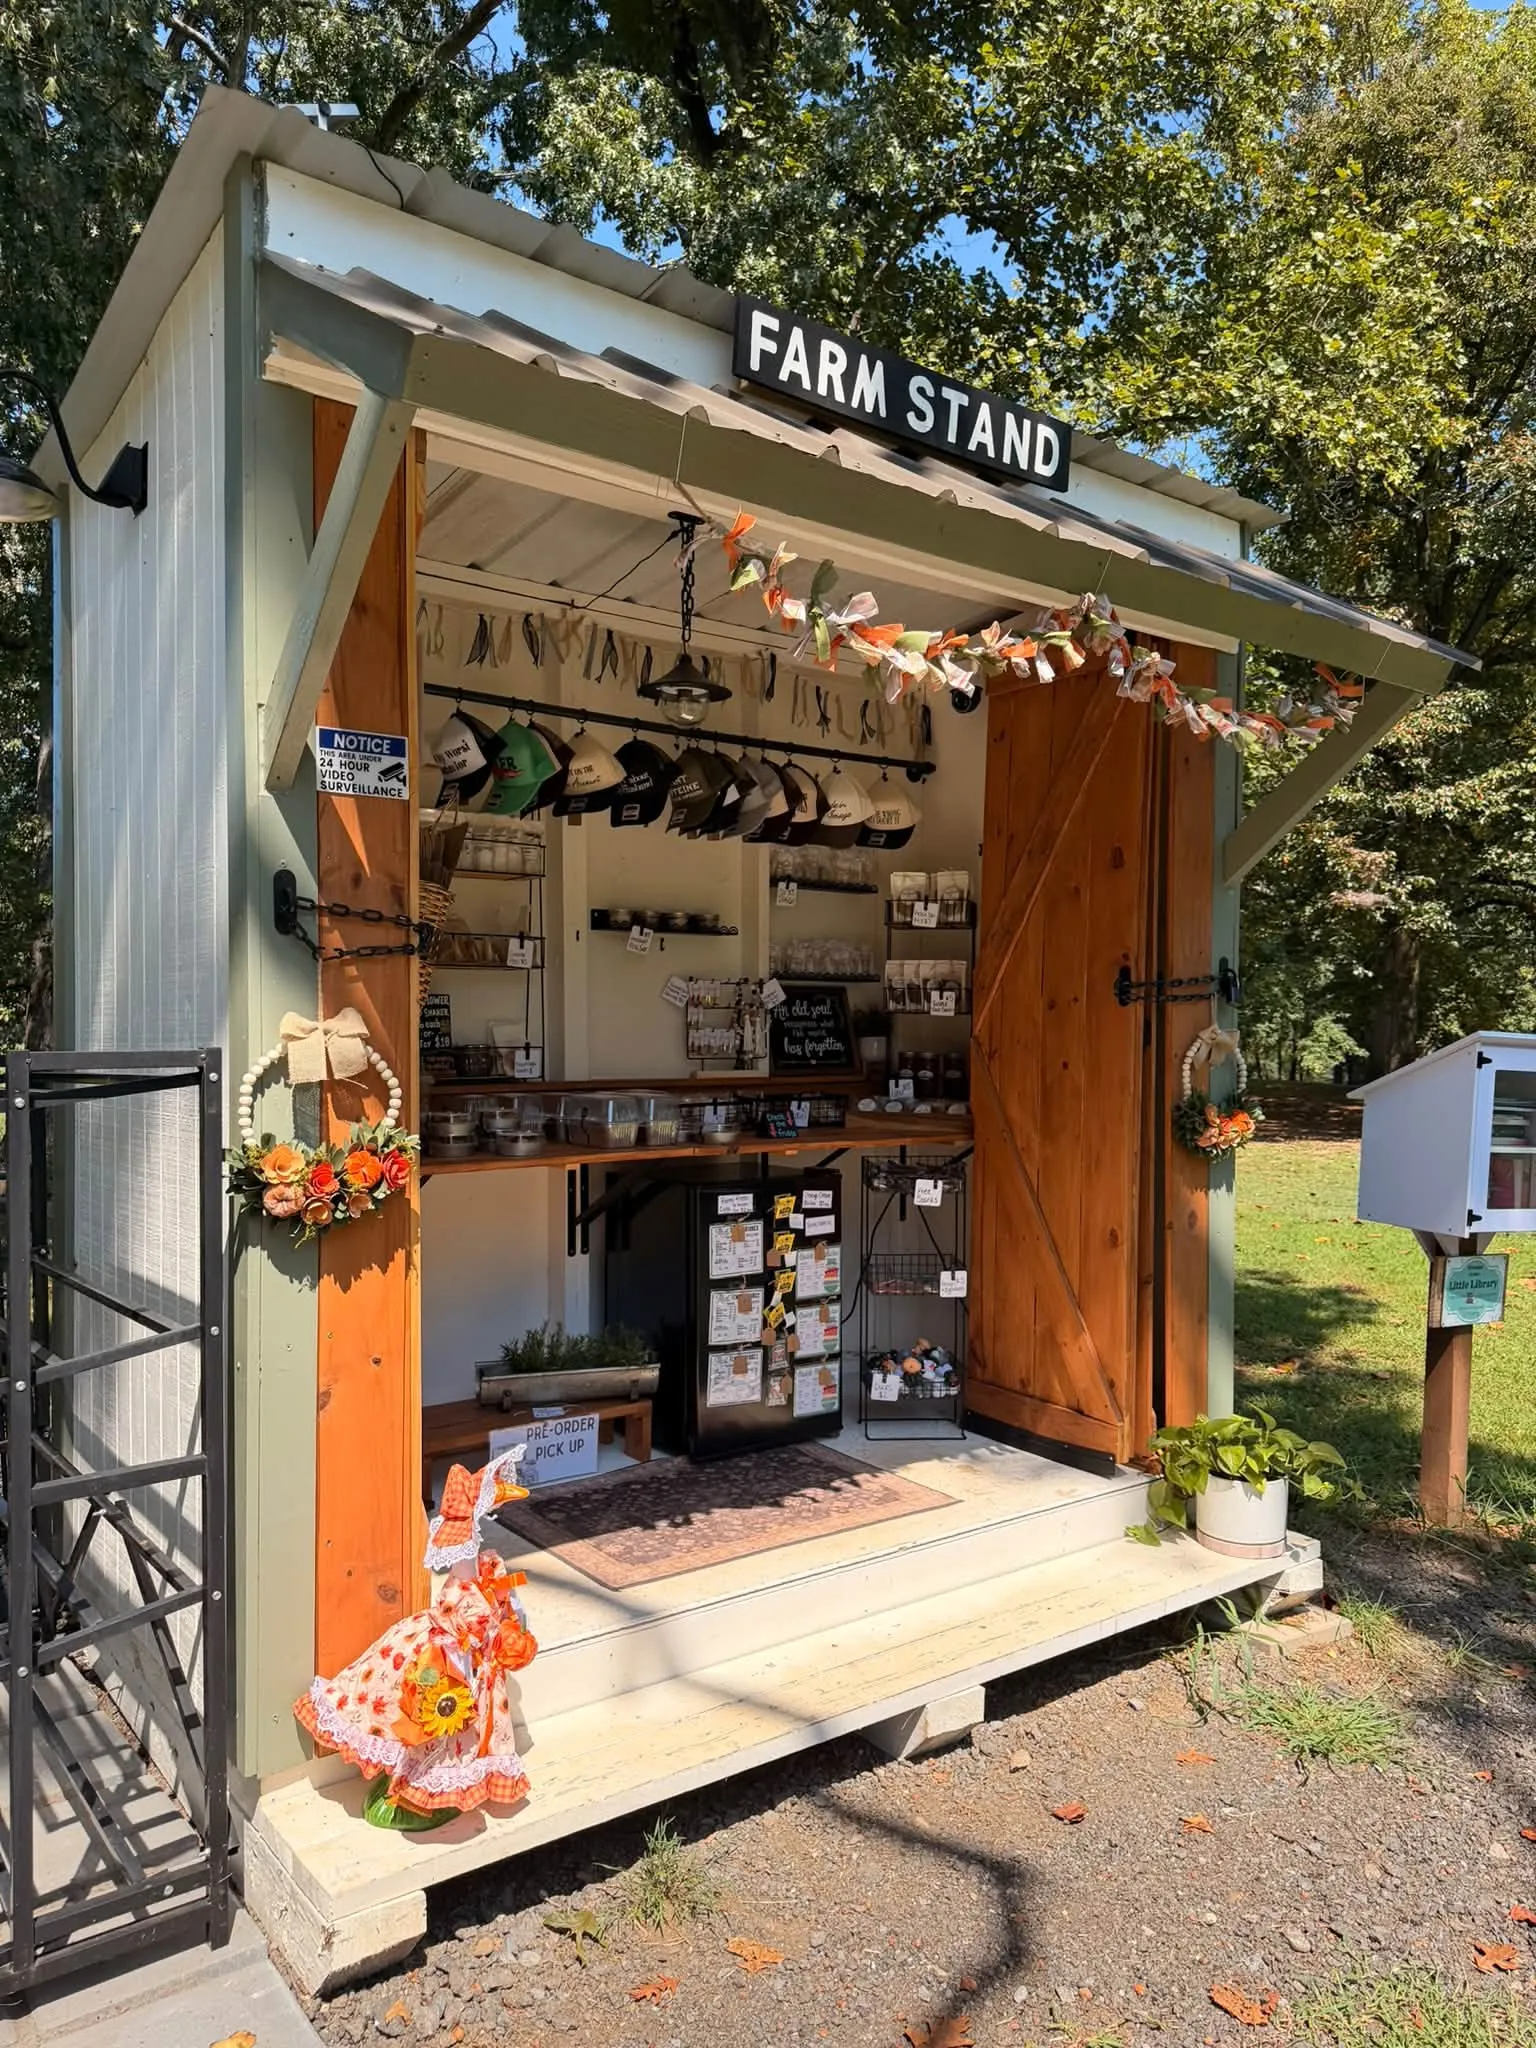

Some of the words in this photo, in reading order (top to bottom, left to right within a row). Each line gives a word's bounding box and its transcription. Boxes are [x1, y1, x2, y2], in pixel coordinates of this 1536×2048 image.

[750, 310, 887, 418] FARM
[906, 375, 1060, 478] STAND
[333, 733, 391, 753] NOTICE
[319, 758, 334, 768] 24
[340, 760, 370, 773] HOUR
[320, 750, 336, 758] THIS
[338, 752, 356, 760] AREA
[359, 754, 383, 763] UNDER
[320, 769, 355, 782] VIDEO
[320, 780, 403, 798] SURVEILLANCE
[791, 999, 810, 1016] old
[804, 1037, 845, 1058] forgotten
[1449, 1280, 1470, 1291] Little
[1471, 1279, 1497, 1289] Library
[526, 1417, 595, 1440] PRE-ORDER
[535, 1442, 564, 1460] PICK
[569, 1439, 584, 1453] UP
